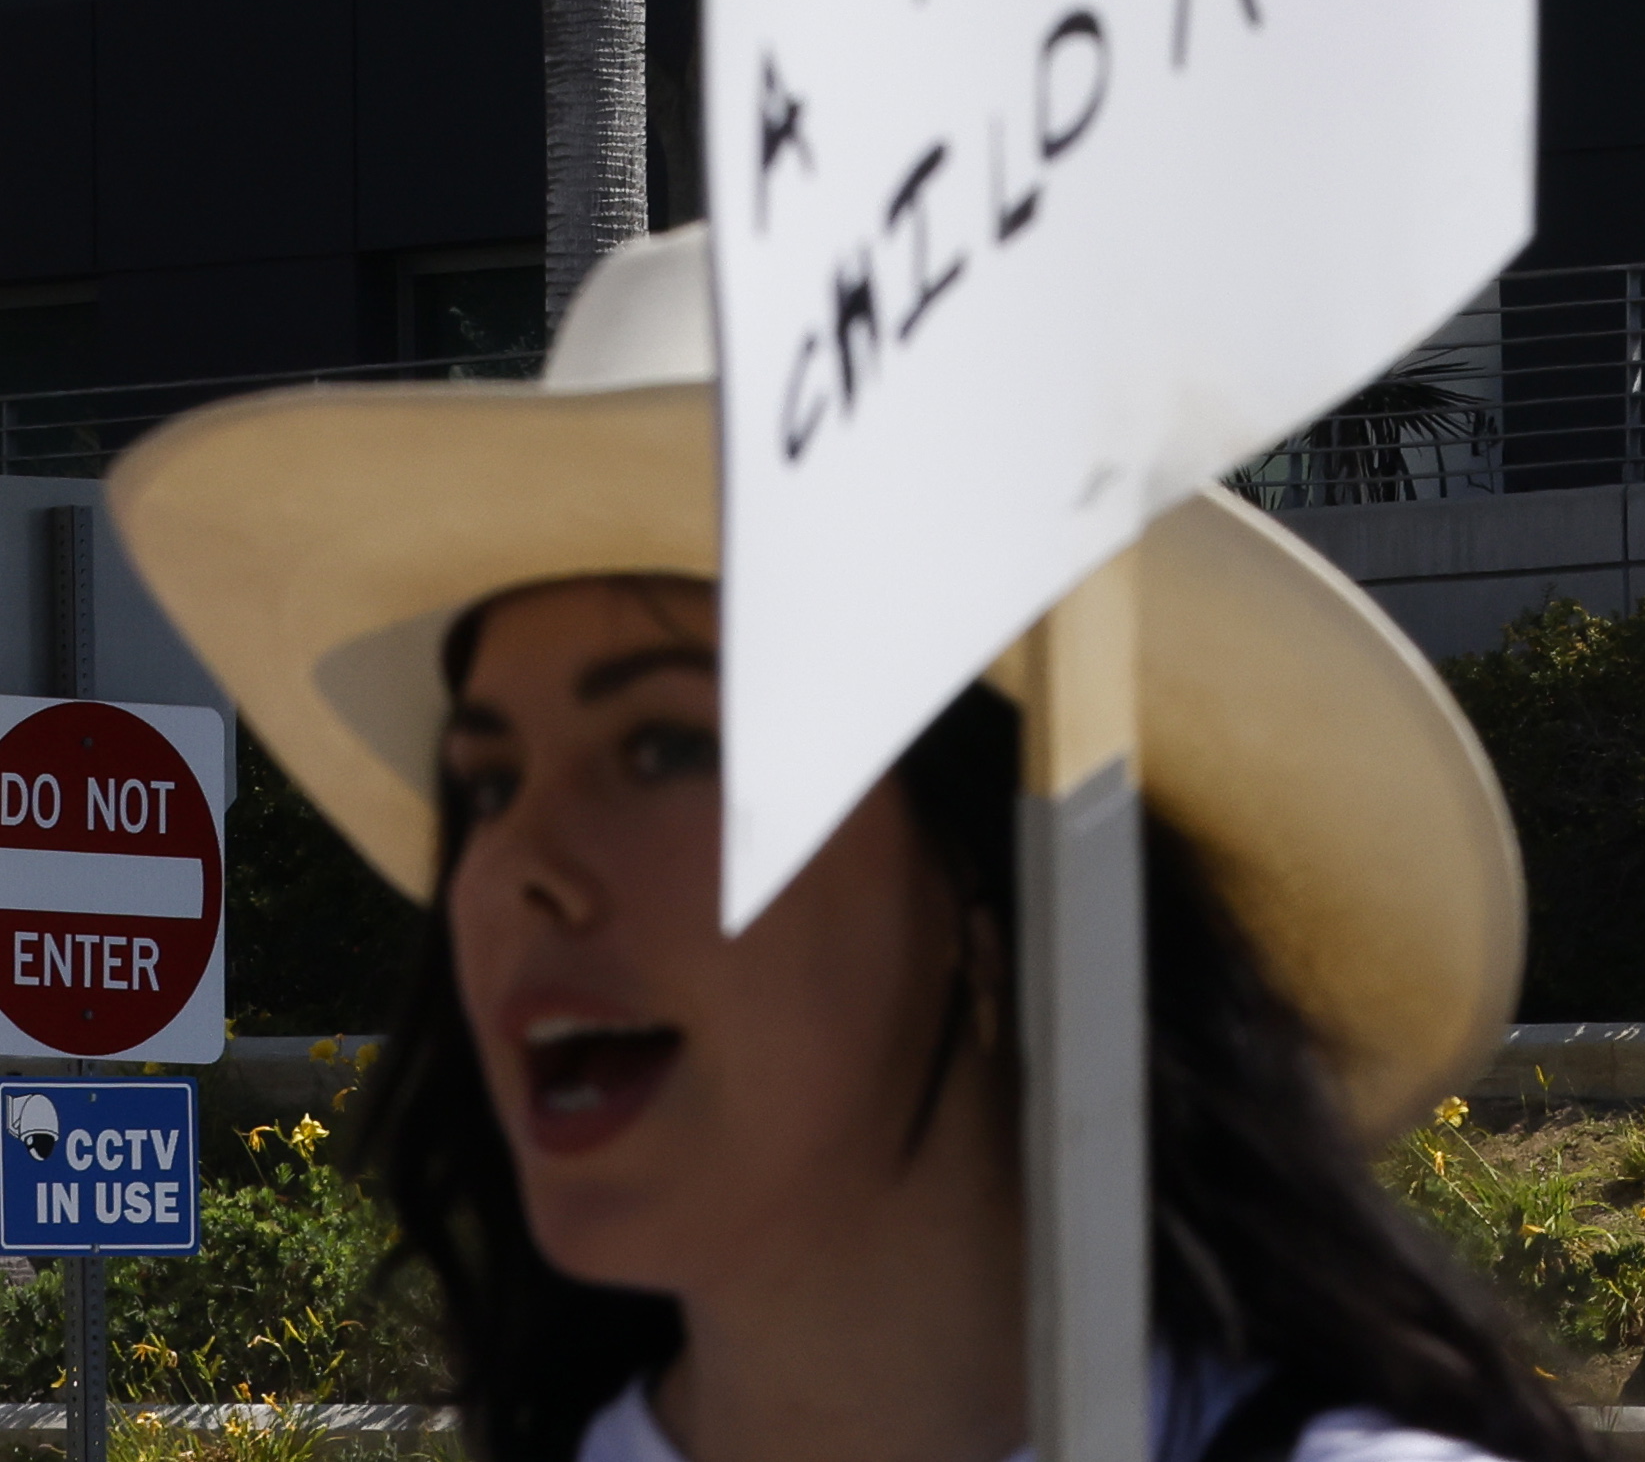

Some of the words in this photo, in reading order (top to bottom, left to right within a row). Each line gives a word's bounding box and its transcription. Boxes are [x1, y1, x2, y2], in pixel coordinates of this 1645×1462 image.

[753, 50, 819, 234] A
[780, 8, 1111, 463] CHILD
[1, 773, 60, 829] DO
[87, 776, 175, 834] NOT
[14, 931, 160, 992] ENTER
[66, 1129, 179, 1171] CCTV
[36, 1182, 79, 1224] IN
[96, 1181, 180, 1224] USE
